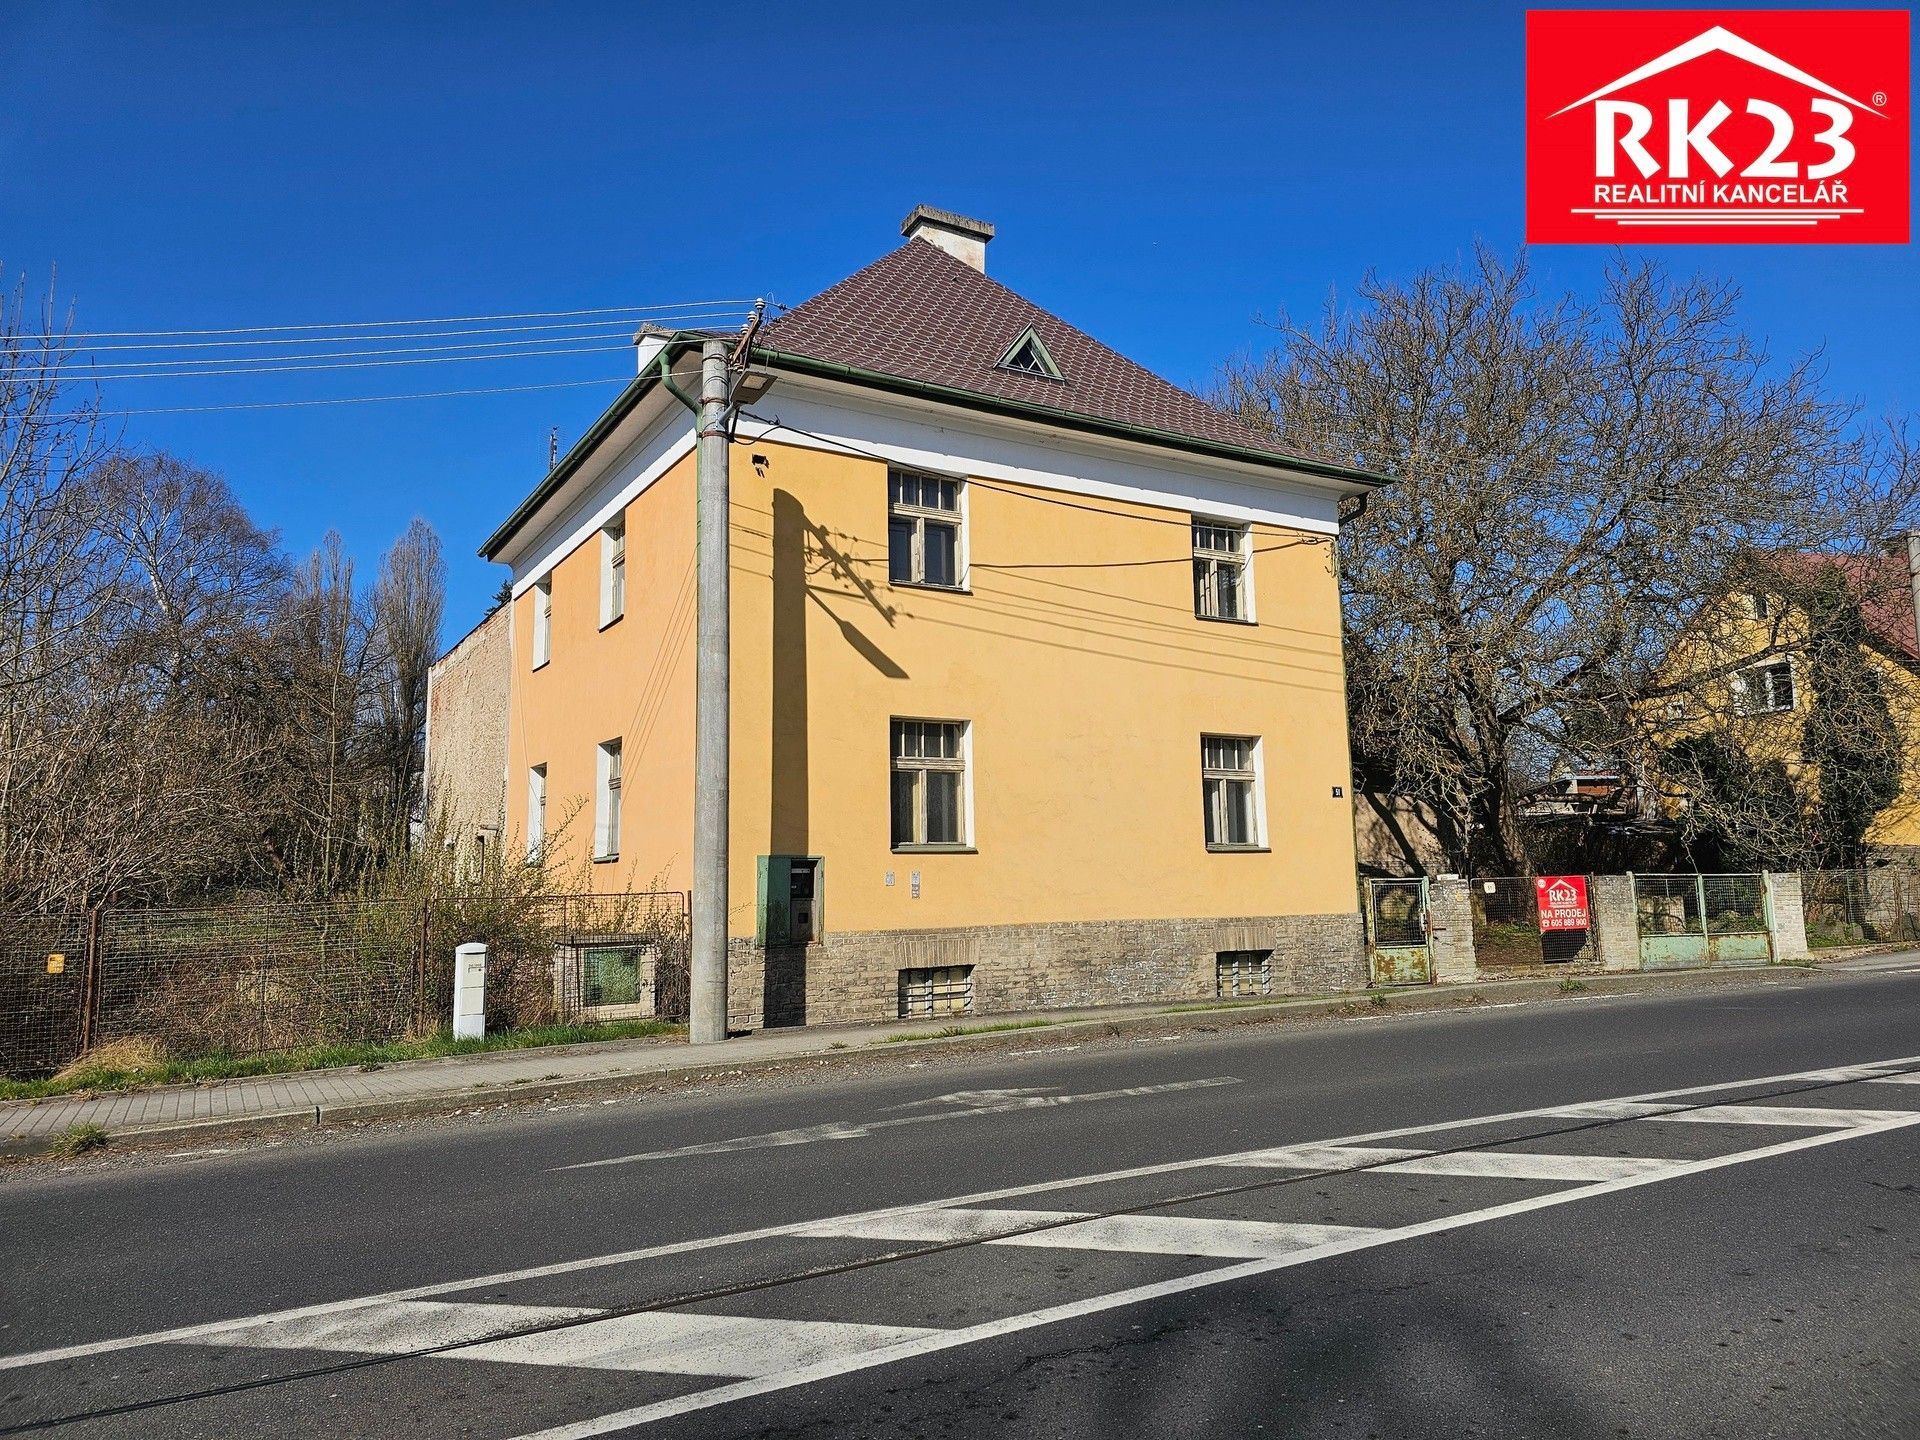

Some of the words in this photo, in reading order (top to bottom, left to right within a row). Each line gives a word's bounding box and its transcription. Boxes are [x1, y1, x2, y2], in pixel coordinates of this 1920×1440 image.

[1549, 889, 1577, 902] RK23
[1540, 909, 1553, 919] NA
[1554, 908, 1587, 918] PRODEJ
[1551, 919, 1563, 927] 605
[1575, 918, 1587, 926] 900
